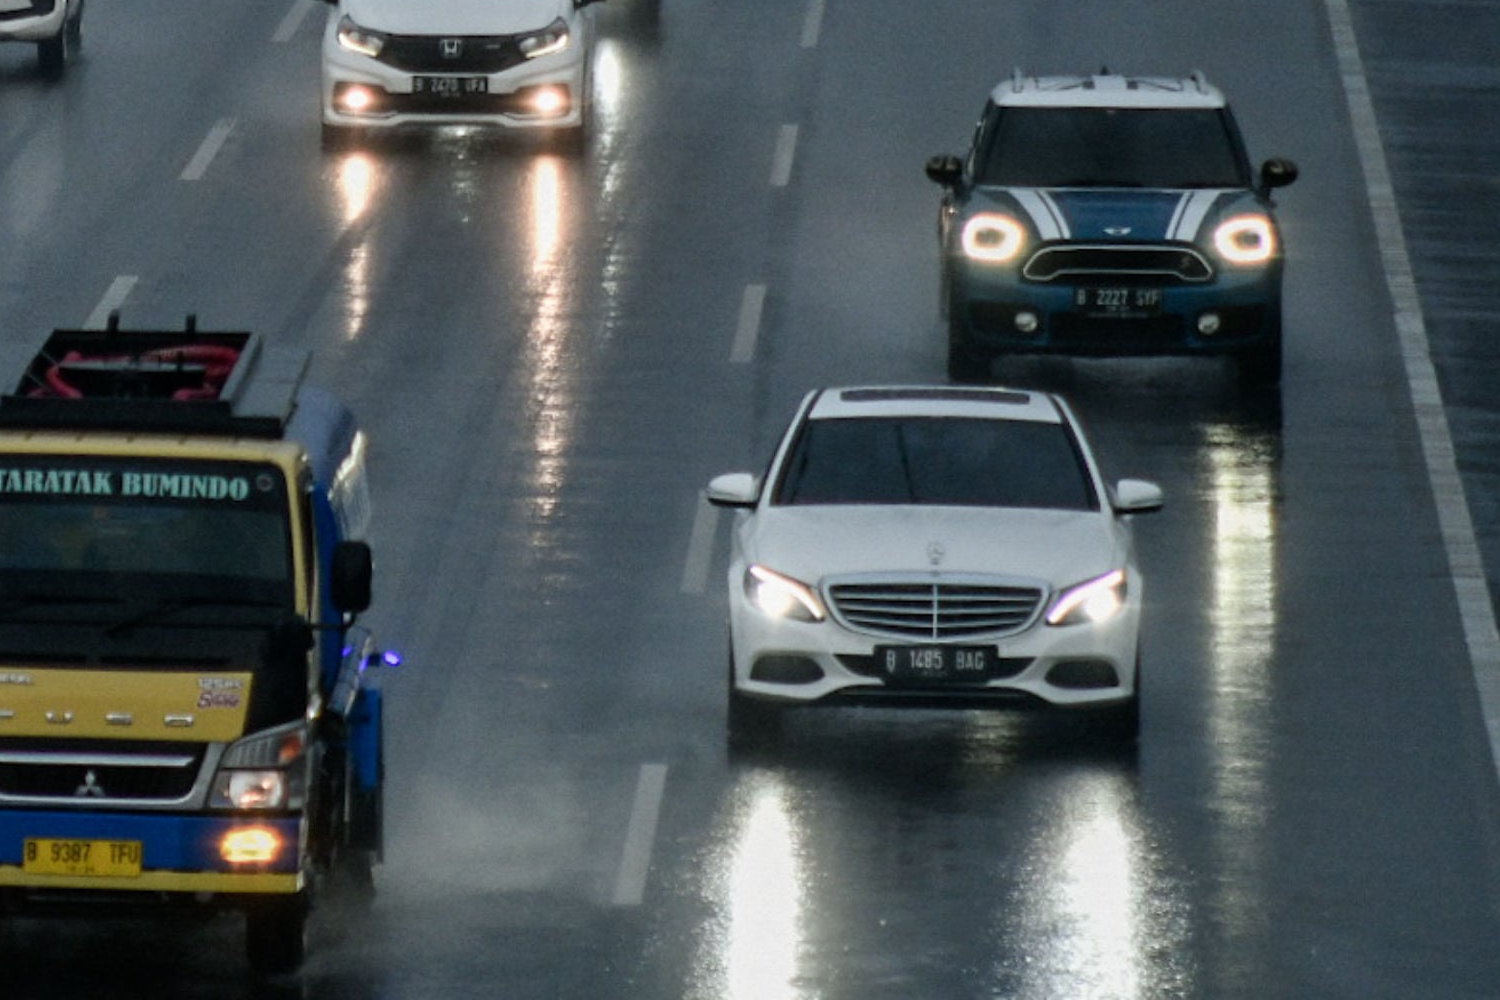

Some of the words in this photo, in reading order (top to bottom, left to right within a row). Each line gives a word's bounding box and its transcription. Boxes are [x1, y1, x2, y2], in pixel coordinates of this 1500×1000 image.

[1095, 288, 1129, 306] 2227
[121, 472, 250, 501] BUMINDO
[885, 649, 896, 670] B
[909, 649, 944, 670] 1485
[27, 842, 37, 861] B
[50, 843, 91, 863] 9387
[110, 843, 139, 864] TFU
